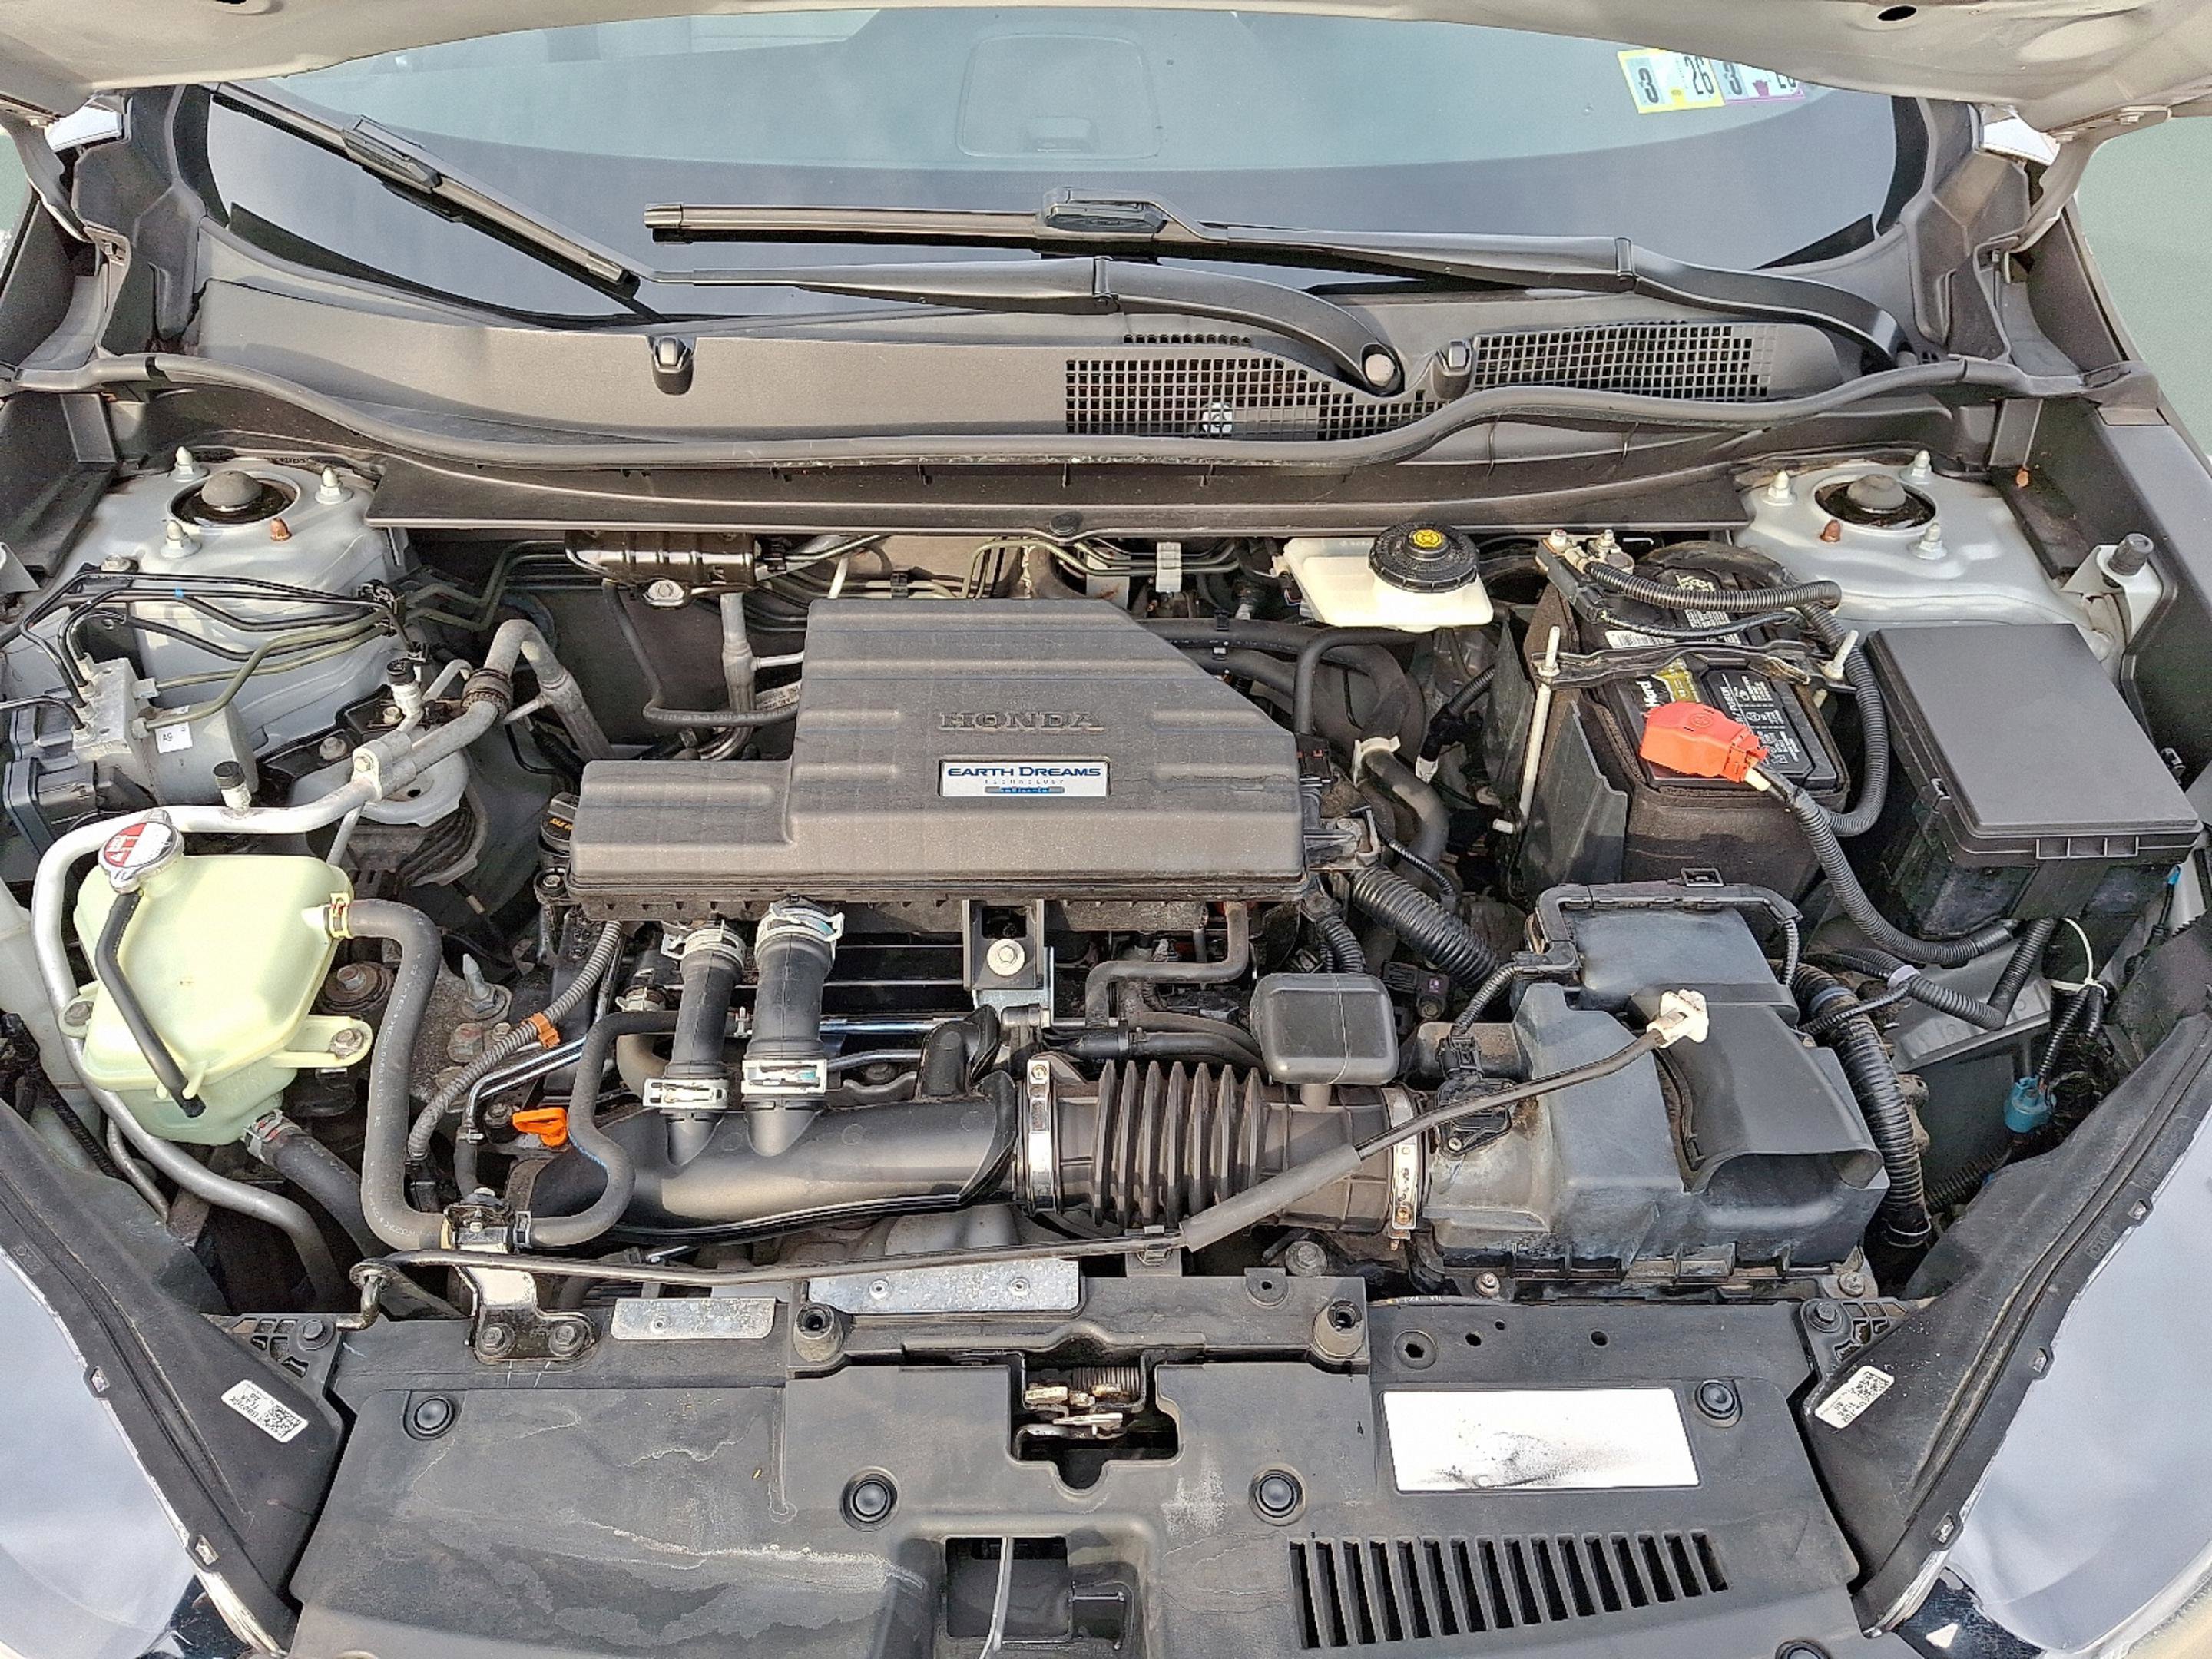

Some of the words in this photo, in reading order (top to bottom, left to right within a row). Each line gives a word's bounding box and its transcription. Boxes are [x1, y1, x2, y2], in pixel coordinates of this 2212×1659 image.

[1637, 67, 1660, 104] 3
[1684, 56, 1715, 95] 26
[1723, 61, 1743, 96] 3
[939, 711, 1106, 732] HONDA
[947, 767, 1014, 777] EARTH
[1018, 766, 1101, 777] DREAMS
